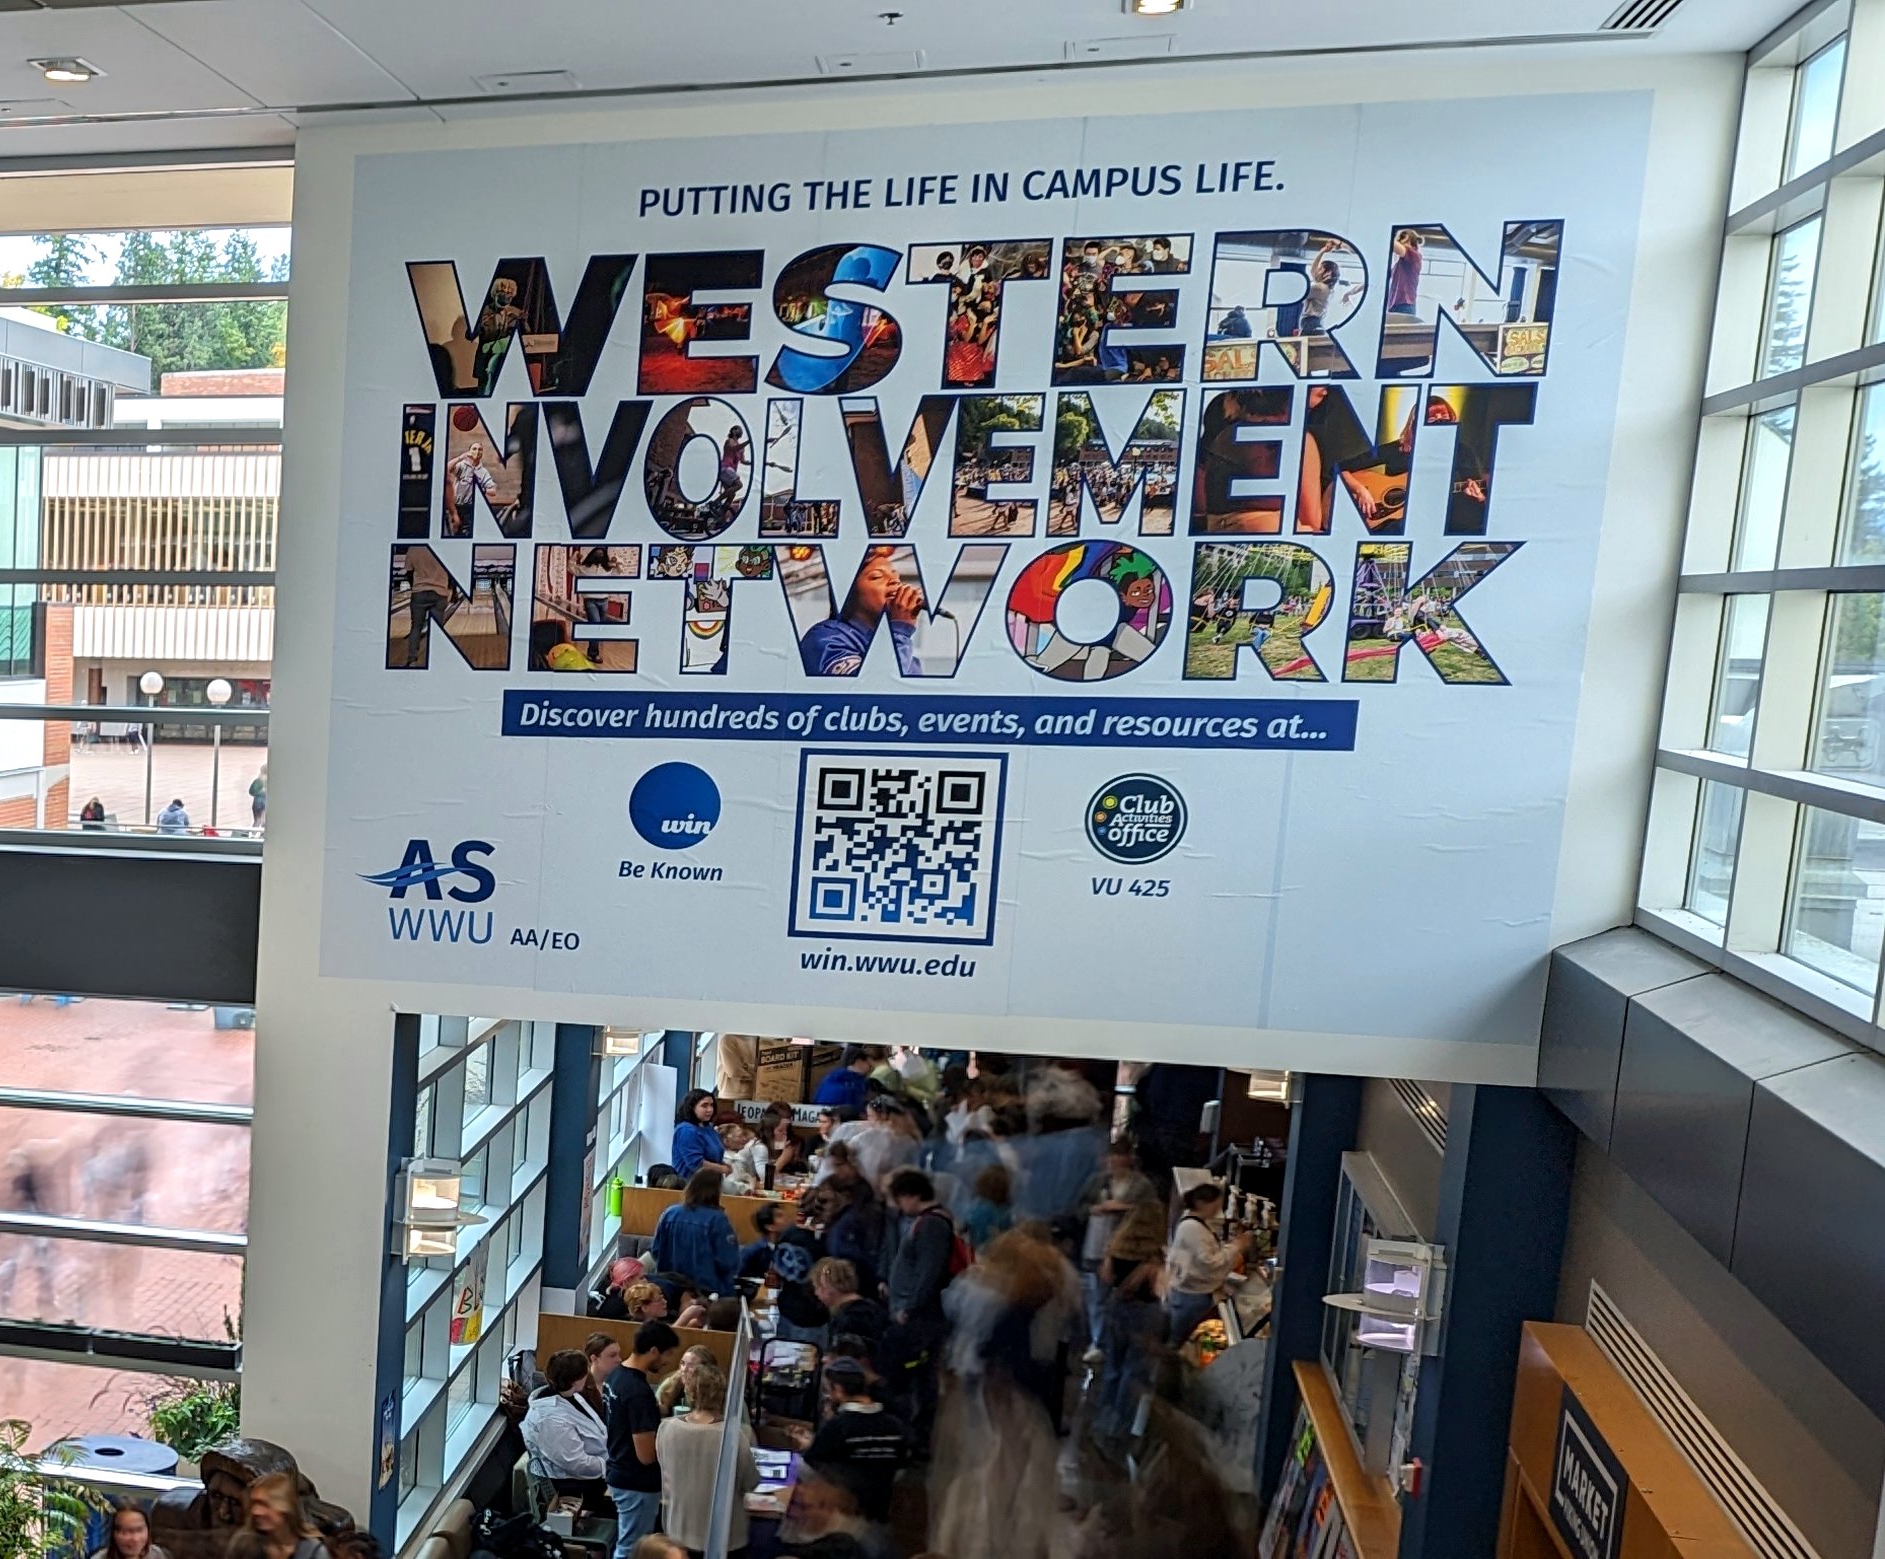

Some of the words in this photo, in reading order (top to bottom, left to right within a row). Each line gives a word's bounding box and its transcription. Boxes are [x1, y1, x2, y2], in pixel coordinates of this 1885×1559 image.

[639, 183, 791, 217] PUTTING
[803, 178, 873, 211] THE
[884, 175, 958, 208] LIFE
[972, 172, 1009, 203] IN
[1022, 165, 1182, 200] CAMPUS
[1195, 160, 1285, 194] LIFE.
[405, 219, 1565, 399] WESTERN
[396, 383, 1539, 540] INVOLVEMENT
[385, 541, 1525, 686] NETWORK
[519, 700, 638, 728] Discover
[644, 703, 779, 730] hundreds
[786, 705, 823, 736] of
[823, 705, 909, 737] clubs,
[918, 709, 1026, 739] events,
[1035, 708, 1097, 736] and
[1102, 714, 1258, 739] resources
[1266, 714, 1328, 740] at...
[1108, 813, 1173, 827] Activities
[1119, 794, 1175, 815] Club
[661, 813, 710, 836] win
[388, 838, 497, 904] AS
[618, 860, 646, 879] Be
[650, 862, 723, 882] Known
[1091, 877, 1123, 896] VU
[1128, 879, 1171, 898] 425
[388, 907, 493, 945] WWU
[509, 928, 580, 952] AA/EO
[800, 946, 978, 979] win.wwu.edu
[1563, 1444, 1609, 1540] MARKET
